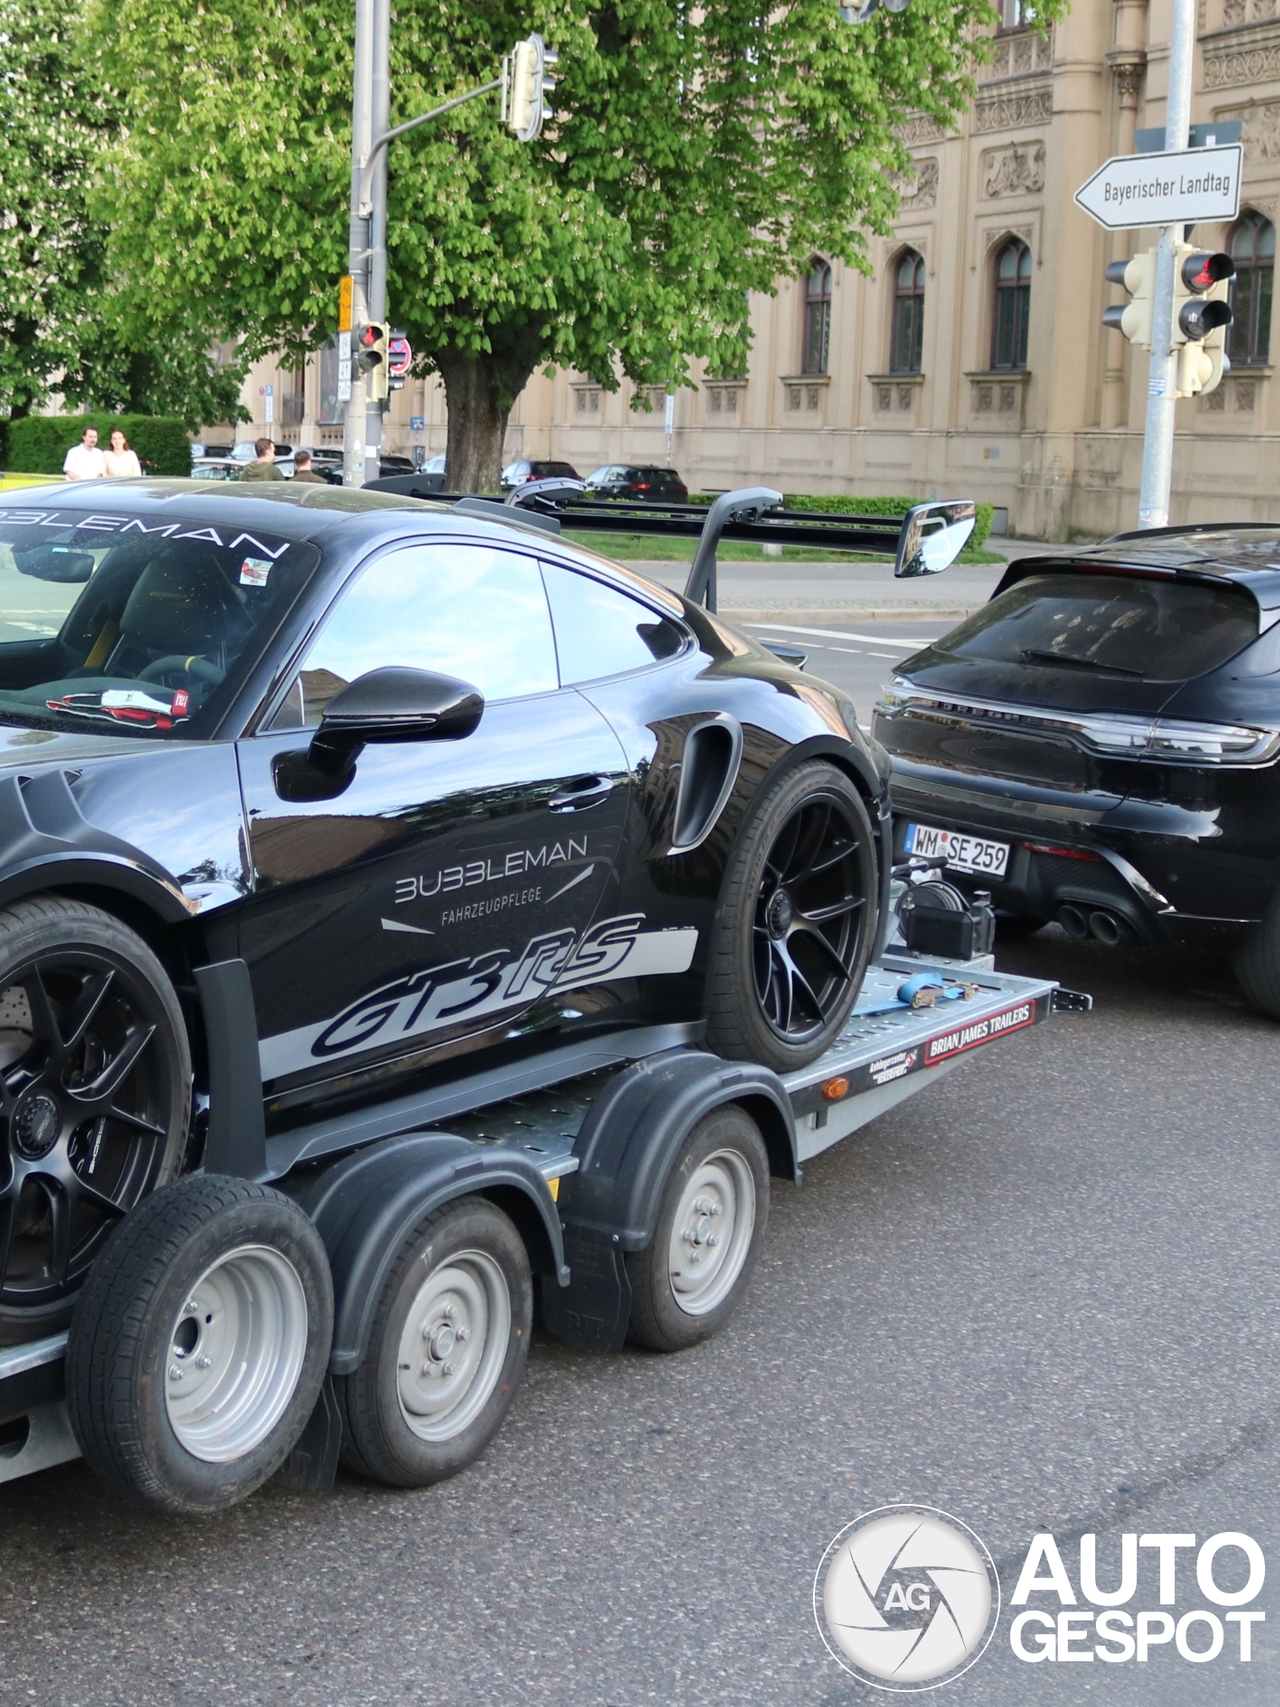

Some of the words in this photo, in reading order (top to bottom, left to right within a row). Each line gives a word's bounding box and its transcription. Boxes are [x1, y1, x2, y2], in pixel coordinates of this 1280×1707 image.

[1104, 178, 1176, 206] Bayerischer
[1180, 172, 1231, 196] Landtag
[395, 835, 588, 904] BUBBLEMAN
[915, 828, 939, 856] WM
[947, 836, 971, 863] SE
[971, 841, 1006, 871] 259
[442, 887, 542, 926] FAHRZEUGPFLEGE
[930, 1032, 959, 1057] BRIAN
[959, 1020, 989, 1049] JAMES
[990, 1004, 1030, 1034] TRAILERS
[88, 1116, 107, 1175] ORSCHE
